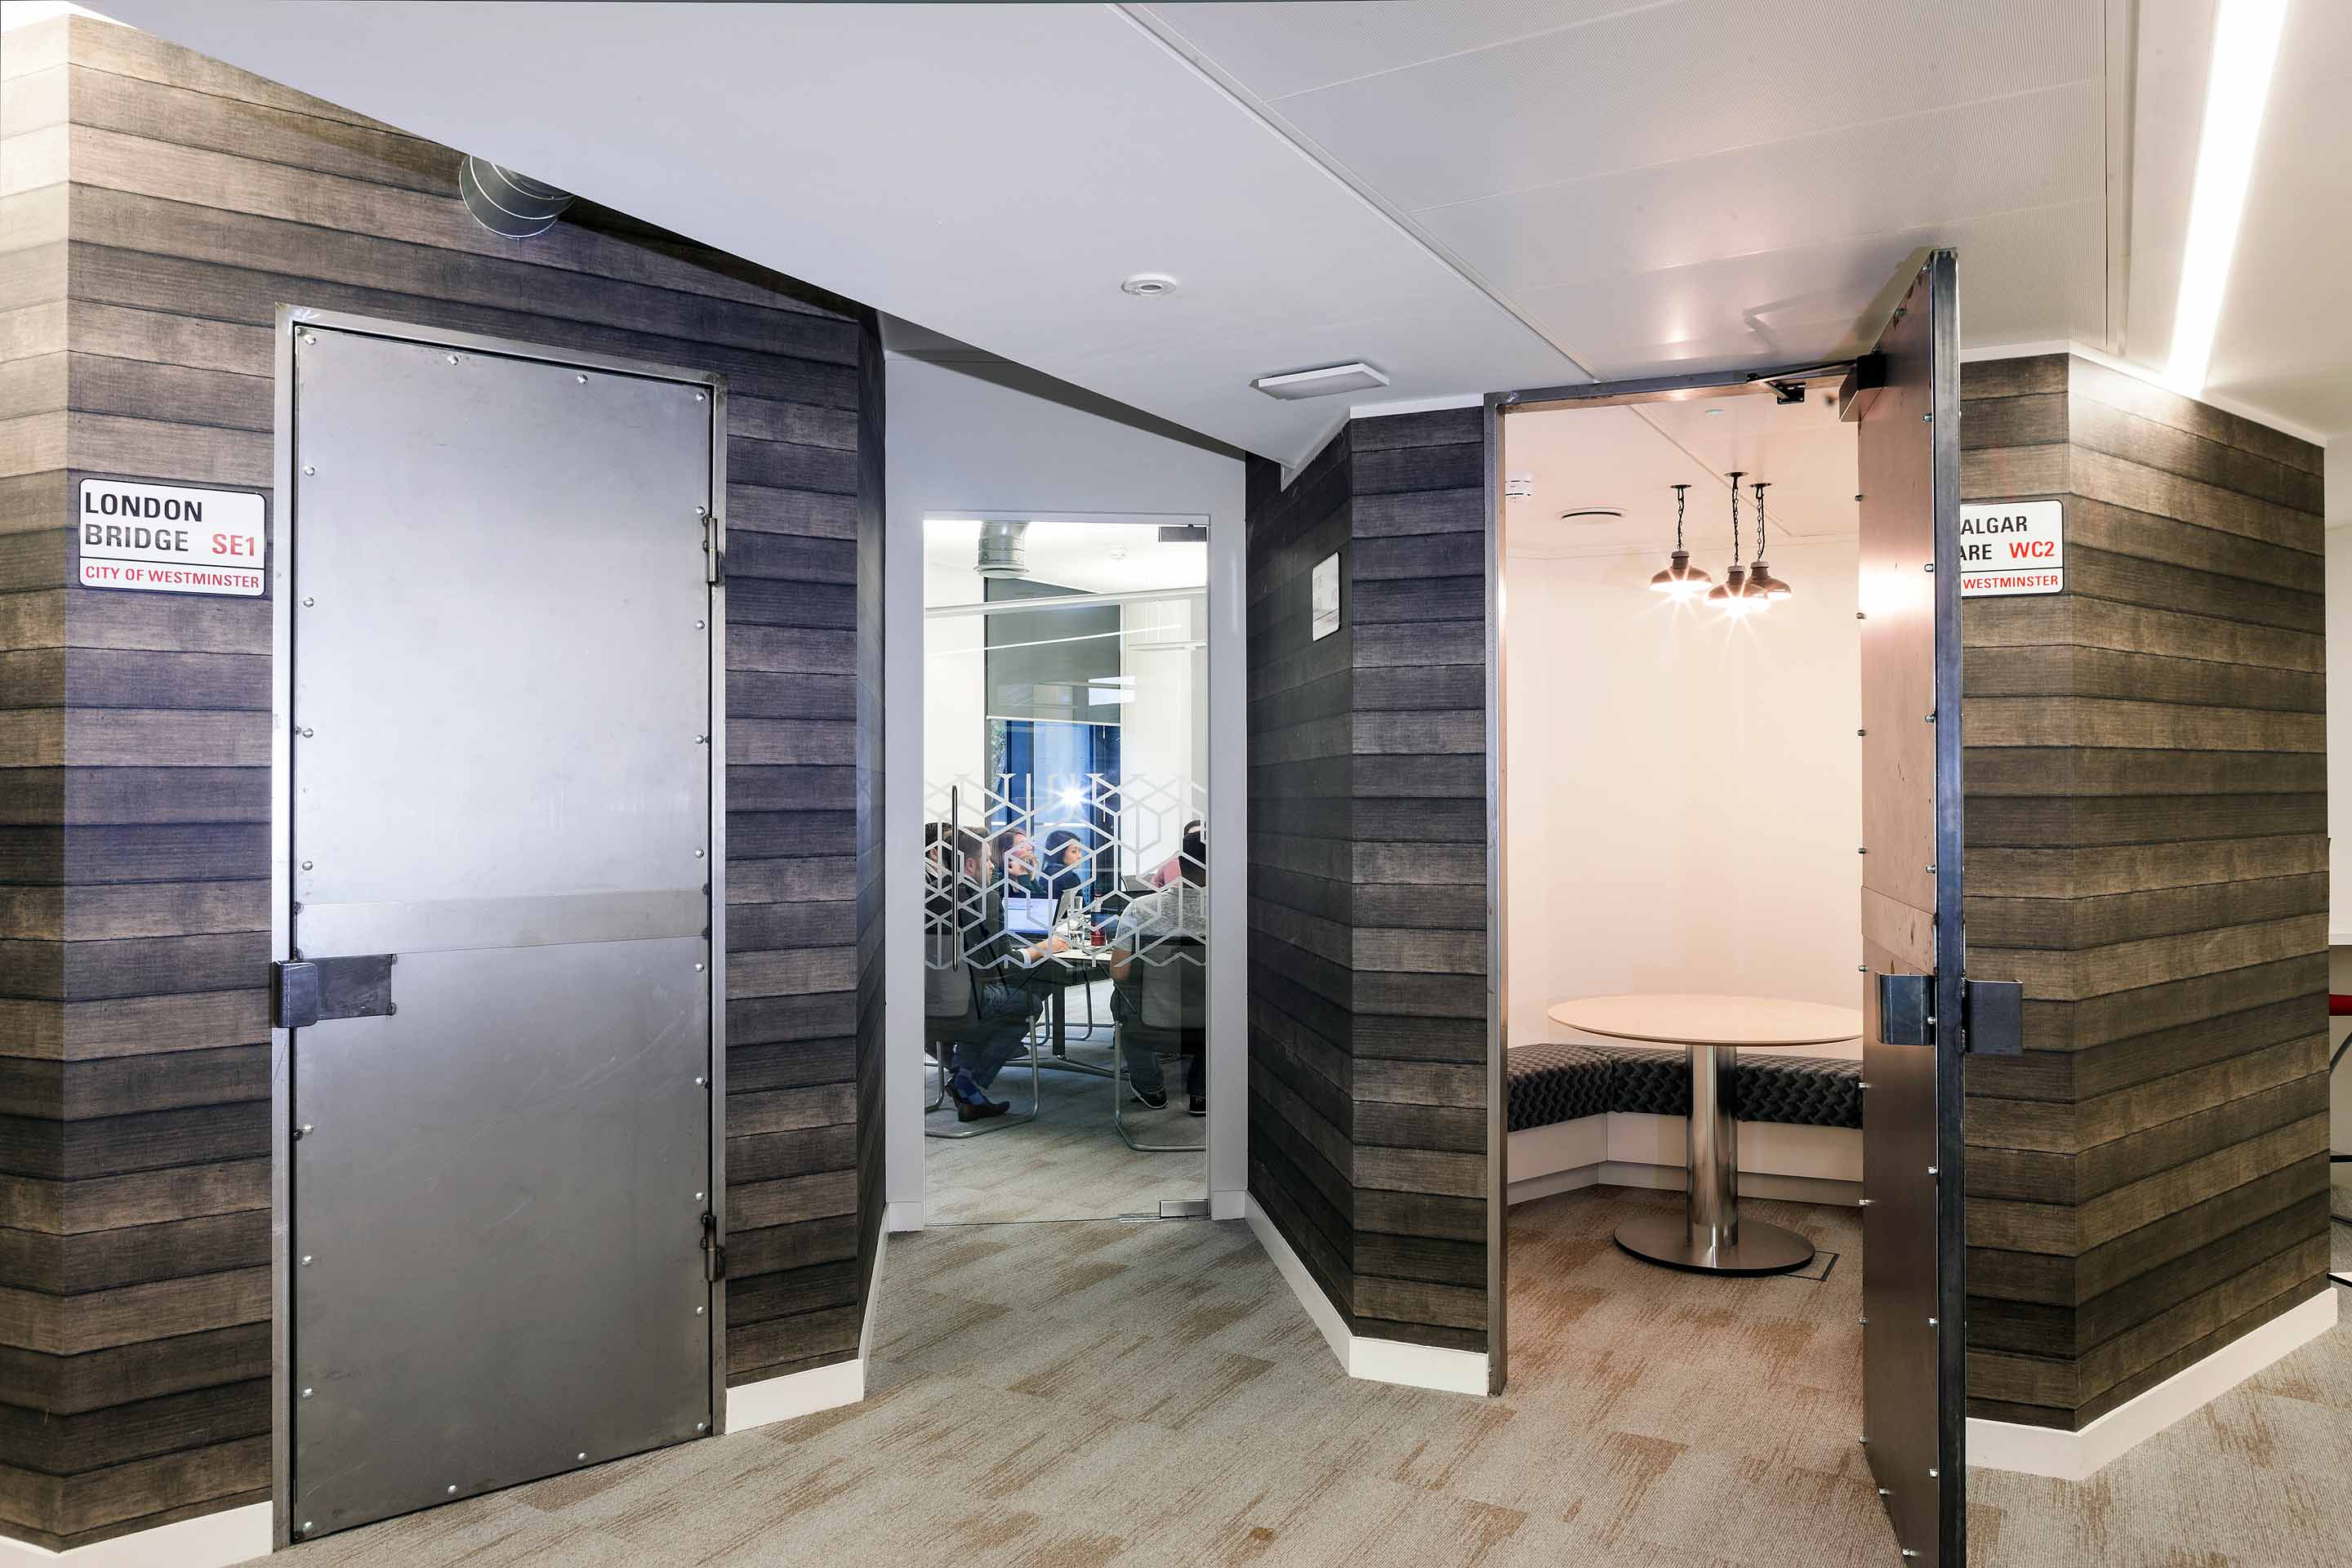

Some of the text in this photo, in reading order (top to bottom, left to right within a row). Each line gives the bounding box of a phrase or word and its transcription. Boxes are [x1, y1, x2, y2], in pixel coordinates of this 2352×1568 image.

[85, 492, 203, 523] LONDON
[1960, 515, 2028, 535] ALGAR
[85, 523, 255, 556] BRIDGE SE1
[1960, 541, 2056, 561] ARE WC2
[85, 565, 259, 588] CITY OF WESTMINSTER
[1962, 575, 2059, 590] WESTMINSTER
